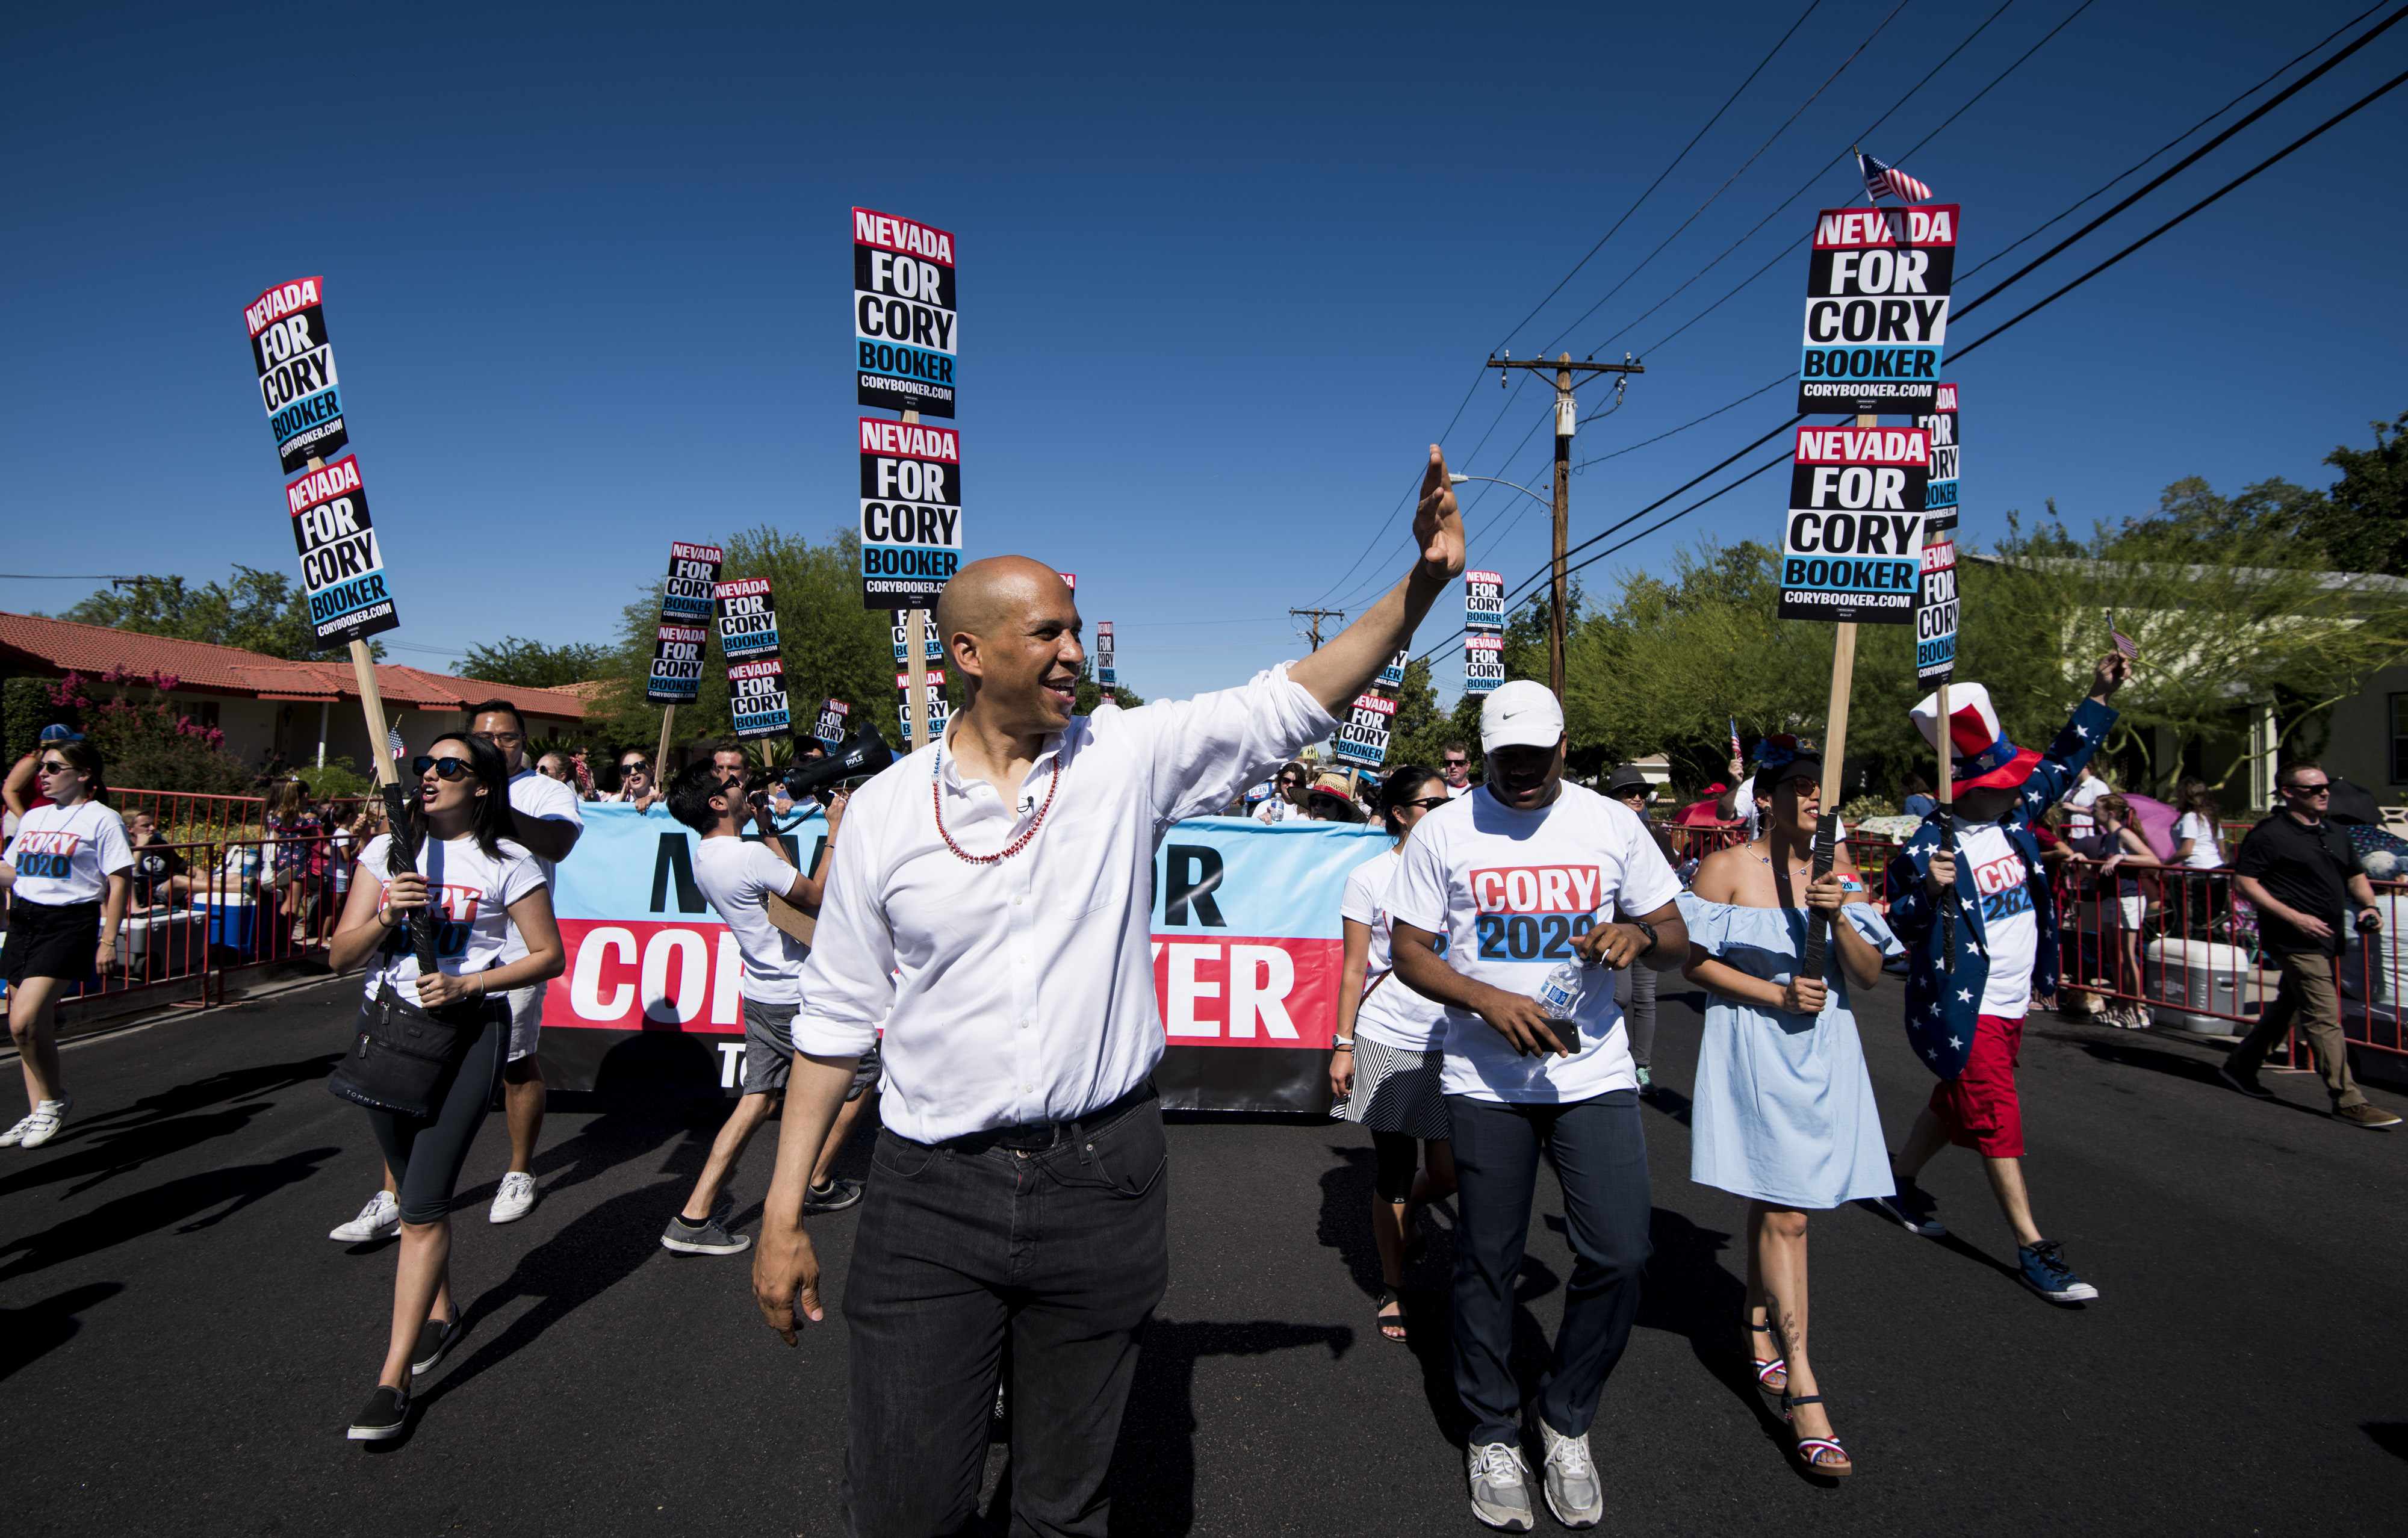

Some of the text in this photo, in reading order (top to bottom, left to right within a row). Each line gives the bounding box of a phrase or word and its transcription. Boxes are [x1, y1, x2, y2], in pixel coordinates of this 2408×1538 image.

[856, 211, 952, 264] NEVADA
[1817, 211, 1952, 245] NEVADA
[872, 250, 942, 305] FOR
[1830, 250, 1929, 294] FOR
[246, 281, 318, 335] NEVADA
[858, 295, 954, 350] CORY
[1808, 300, 1945, 342] CORY
[259, 314, 315, 370] FOR
[860, 341, 952, 383] BOOKER
[1804, 350, 1936, 377] BOOKER
[262, 348, 329, 412] CORY
[861, 375, 952, 401] CORYBOOKER.COM
[1804, 384, 1932, 397] CORYBOOKER.COM
[1935, 388, 1956, 409] ADA
[272, 390, 340, 443] BOOKER
[281, 418, 343, 457] CORYBOOKER.COM
[862, 421, 957, 460] NEVADA
[1798, 432, 1925, 462] NEVADA
[1929, 448, 1957, 480] ORY
[288, 461, 359, 513] NEVADA
[877, 457, 946, 503] FOR
[1811, 467, 1905, 509] FOR
[1926, 483, 1956, 506] OKER
[1925, 506, 1956, 520] YBOOKER.COM
[300, 497, 359, 550] FOR
[864, 502, 958, 545] CORY
[1790, 513, 1921, 555] CORY
[303, 532, 374, 591] CORY
[672, 544, 721, 562] NEVADA
[864, 548, 958, 576] BOOKER
[1919, 544, 1955, 572] NEVADA
[676, 560, 713, 581] FOR
[1466, 572, 1502, 583] NEVADA
[1785, 559, 1913, 589] BOOKER
[667, 578, 715, 598] CORY
[715, 580, 770, 597] NEVADA
[867, 581, 946, 593] CORYBOOKER.C
[1472, 583, 1498, 597] FOR
[1925, 569, 1955, 605] FOR
[311, 574, 388, 621] BOOKER
[664, 596, 712, 613] BOOKER
[725, 595, 765, 616] FOR
[1468, 597, 1502, 612] CORY
[1785, 591, 1910, 608] CORYBOOKER.COM
[318, 602, 391, 637] CORYBOOKER.COM
[663, 610, 710, 619] CORYBOOKER.COM
[721, 612, 773, 635] CORY
[898, 609, 932, 625] FR
[1467, 612, 1501, 622] BOOKER
[1919, 600, 1960, 639] CORY
[659, 627, 706, 642] NEVADA
[894, 625, 937, 642] CRY
[1098, 624, 1112, 634] NEVADA
[662, 642, 698, 660] FOR
[724, 633, 775, 649] BOOKER
[727, 645, 777, 657] CORYBOOKER.COM
[895, 642, 941, 656] BER
[1099, 636, 1111, 651] FOR
[1466, 638, 1501, 648] NEVADA
[1919, 636, 1955, 665] BOOKE
[898, 654, 942, 663] CORR.COM
[1098, 653, 1114, 668] CORY
[1472, 650, 1498, 663] FOR
[653, 660, 702, 678] CORY
[728, 662, 781, 678] NEVADA
[1380, 667, 1401, 680] KER
[1468, 665, 1502, 677] CORY
[650, 678, 697, 690] BOOKER
[737, 677, 777, 696] FOR
[898, 672, 944, 687] NDA
[1375, 678, 1398, 687] OKER.COM
[1467, 679, 1503, 689] BOOKER
[733, 691, 784, 715] CORY
[902, 702, 946, 721] CRY
[736, 712, 787, 728] BOOKER
[821, 710, 842, 727] FOR
[903, 721, 947, 733] BKER
[1351, 708, 1385, 730] FOR
[738, 724, 788, 736] CORYBOOKER.COM
[816, 724, 843, 742] CORY
[1342, 724, 1388, 747] CORY
[824, 740, 836, 751] OKE
[1339, 741, 1382, 760] BOOKER
[846, 754, 863, 766] PYLE
[1338, 754, 1380, 767] CORYBOOKER.COM
[17, 832, 79, 855] CORY
[16, 854, 69, 877] 2020
[1978, 855, 2026, 893] COR
[1475, 869, 1597, 912] CORY
[1985, 882, 2032, 921] 202
[347, 1090, 375, 1104] TOMMY
